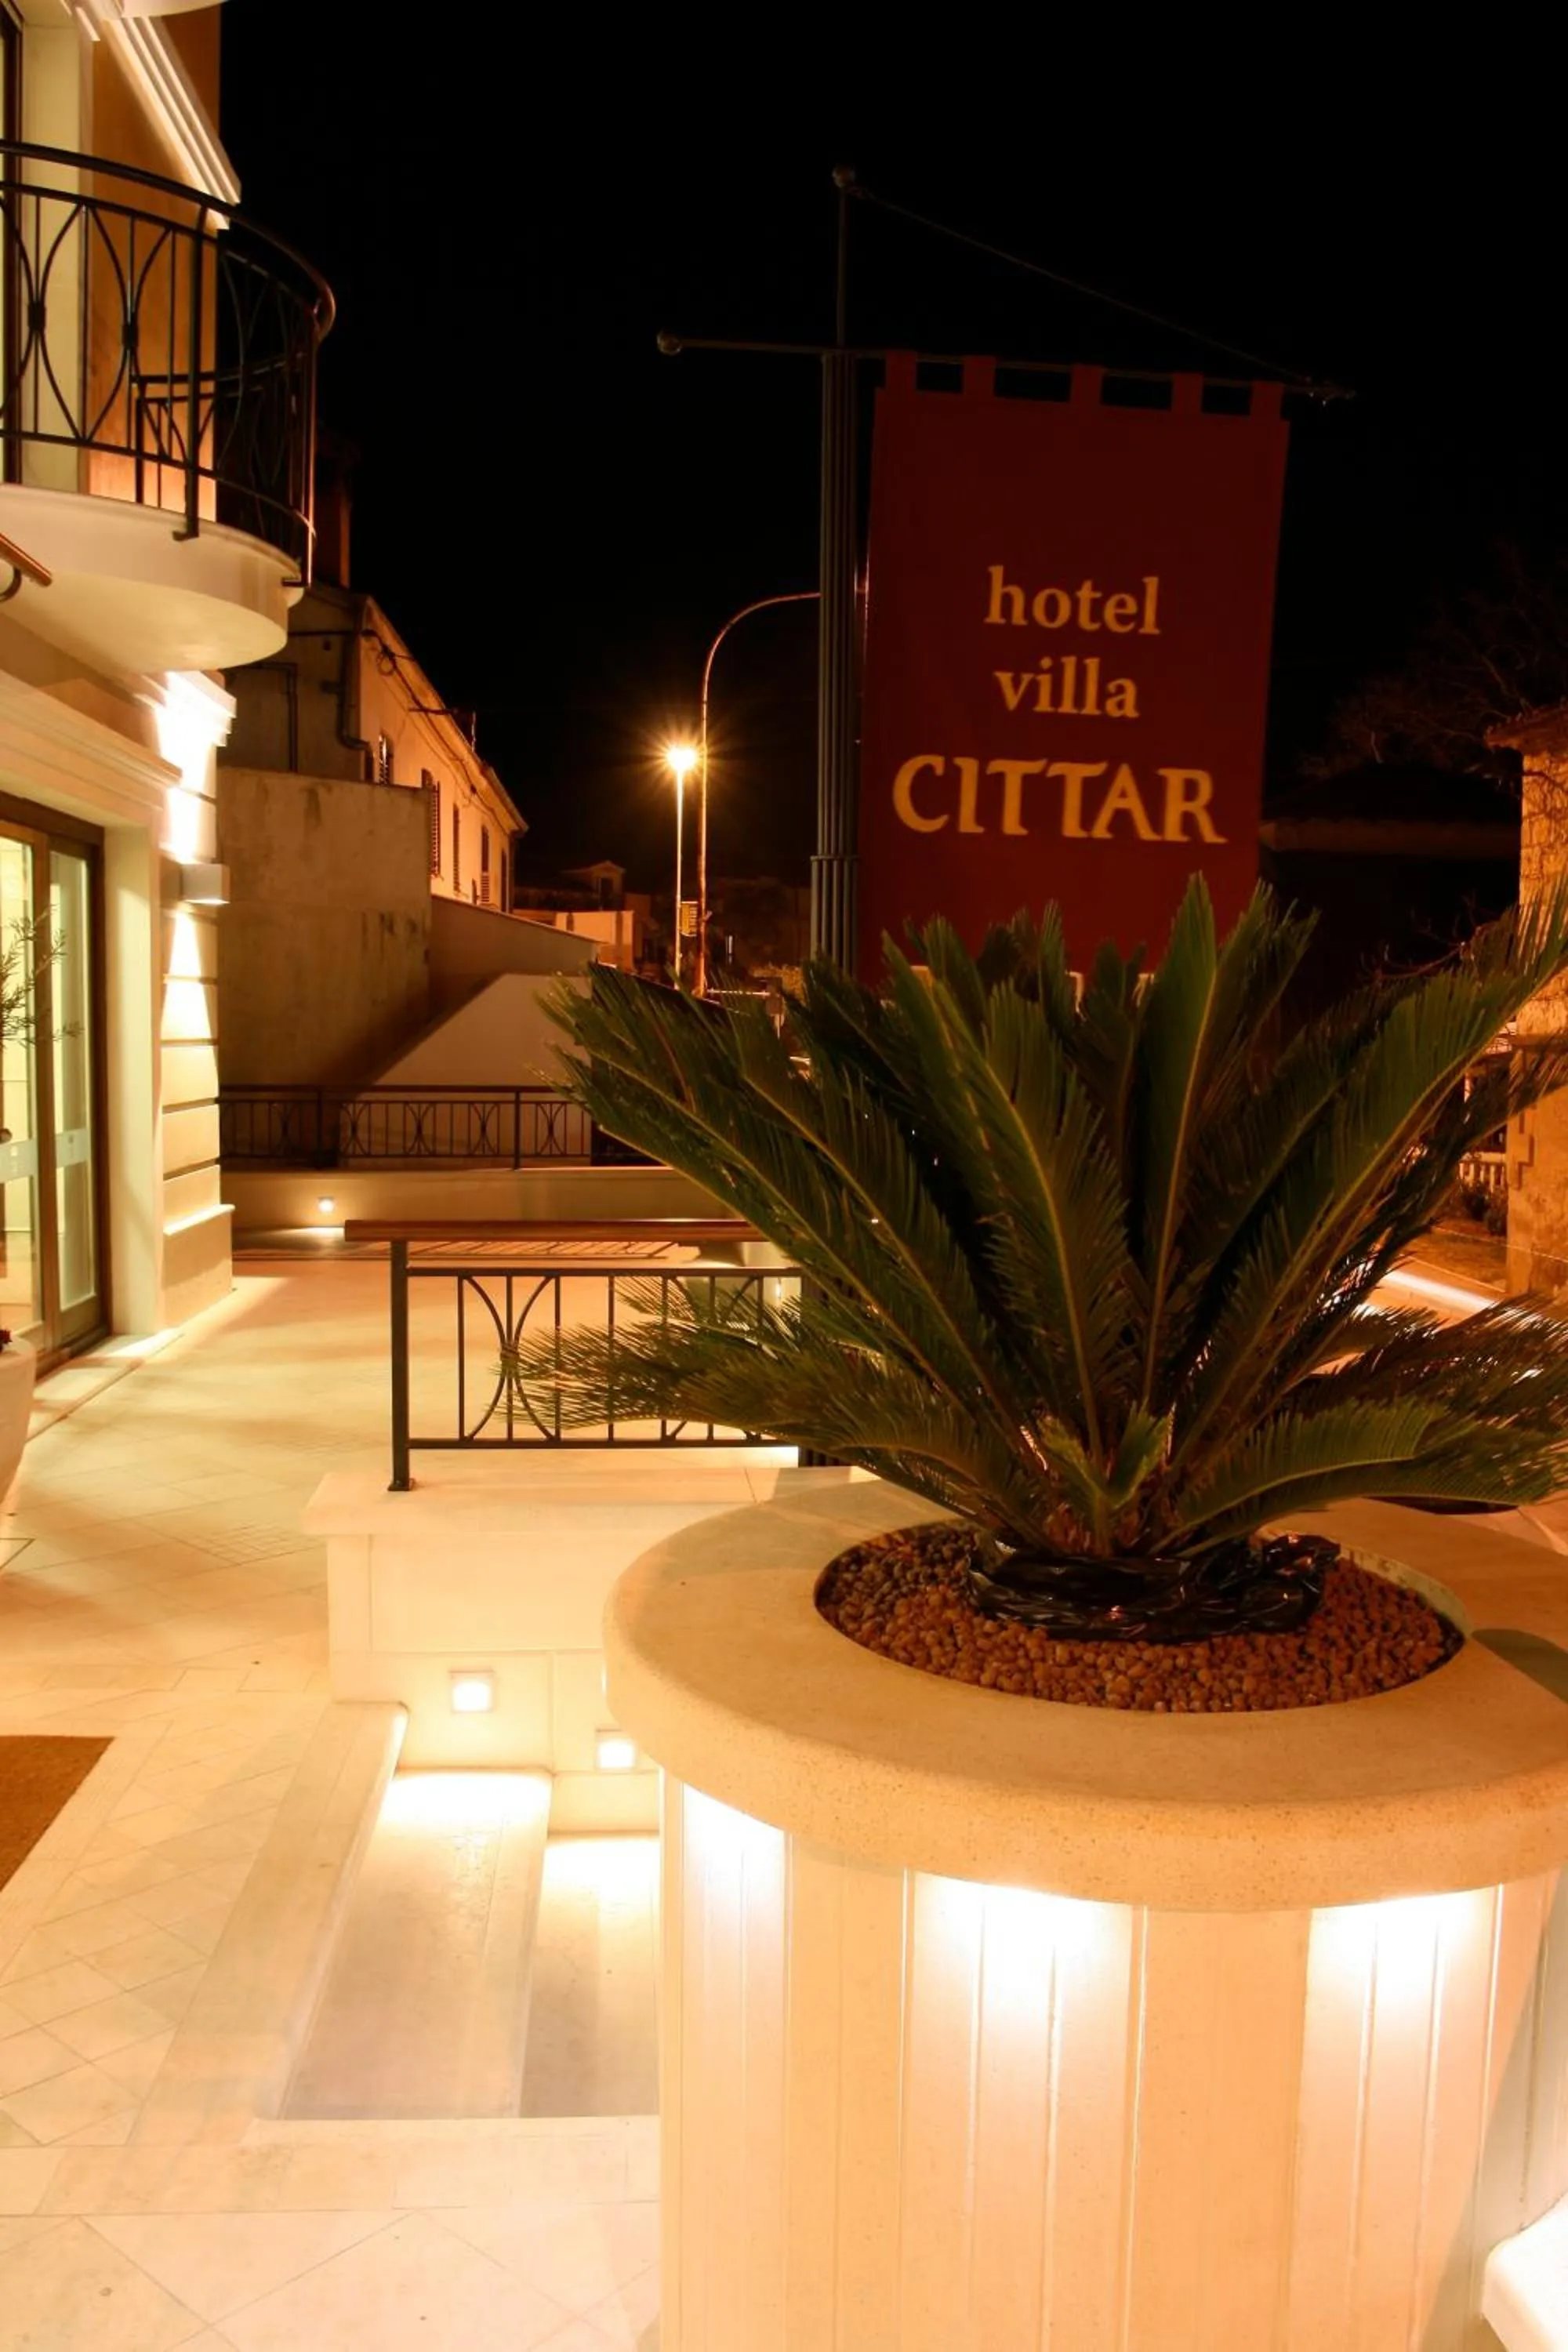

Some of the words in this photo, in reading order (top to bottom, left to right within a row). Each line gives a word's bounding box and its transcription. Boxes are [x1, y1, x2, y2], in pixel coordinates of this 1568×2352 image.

[985, 566, 1160, 633] hotel
[995, 656, 1138, 717] villa
[894, 755, 1226, 843] CITTAR
